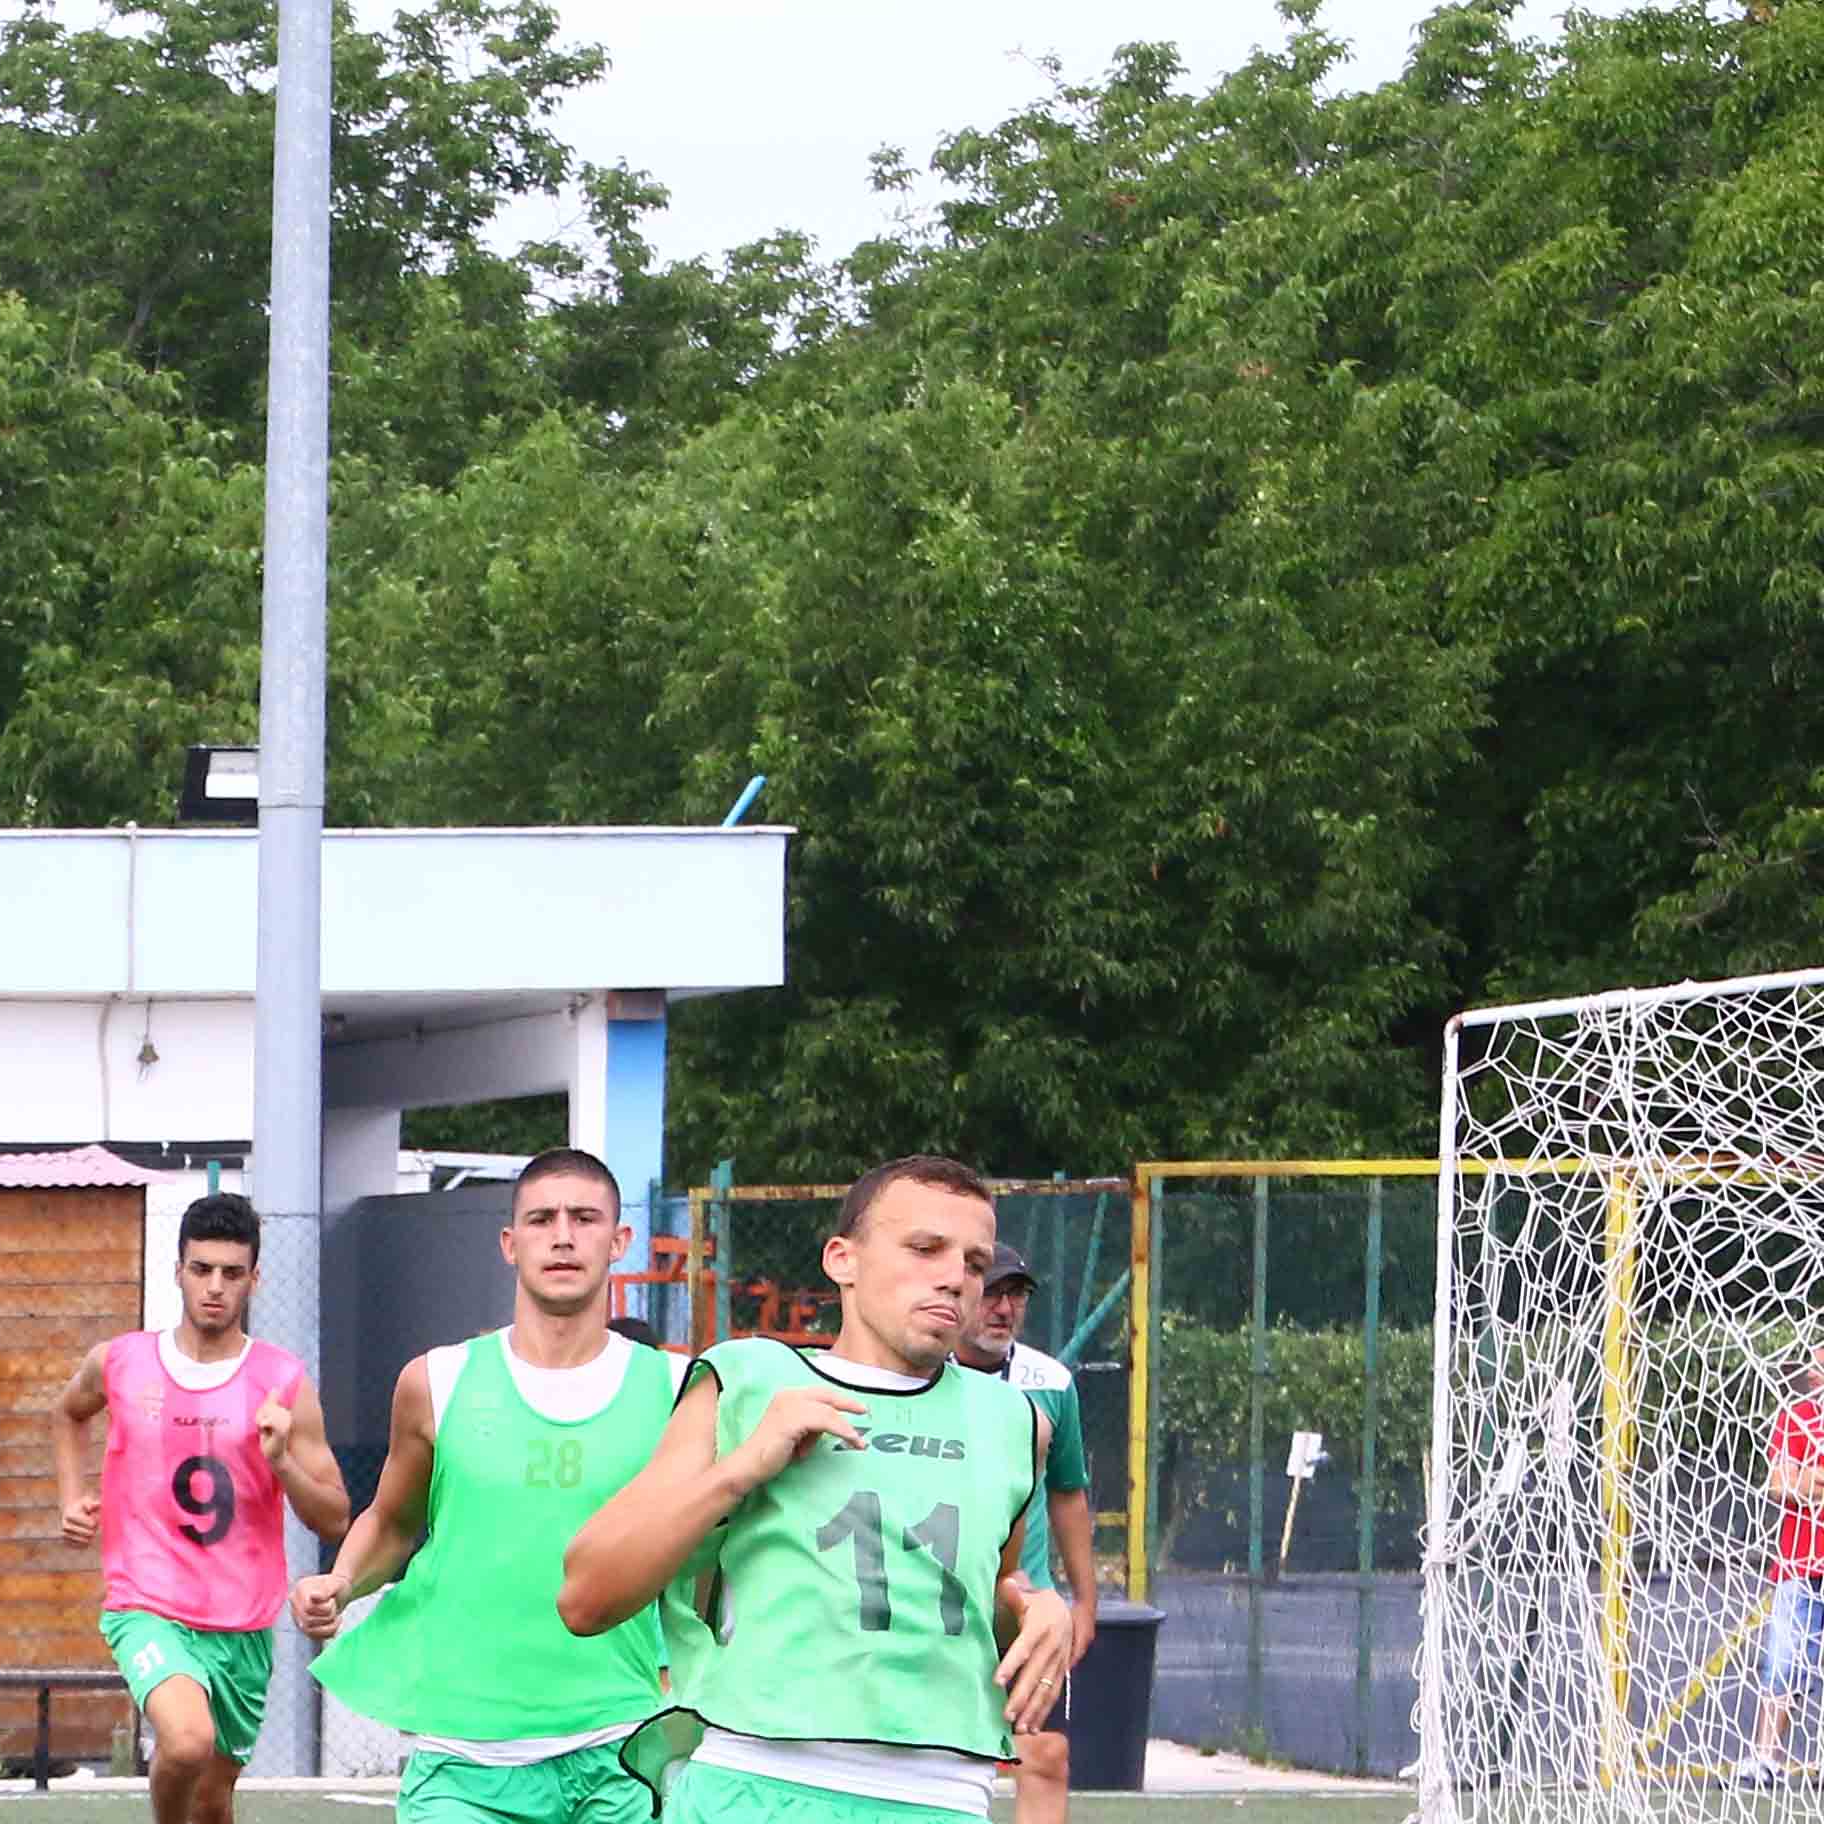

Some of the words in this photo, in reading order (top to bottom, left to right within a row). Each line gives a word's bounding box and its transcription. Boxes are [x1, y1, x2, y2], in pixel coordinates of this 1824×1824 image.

[172, 1456, 235, 1548] 9
[525, 1439, 584, 1489] 28
[816, 1491, 968, 1636] 11
